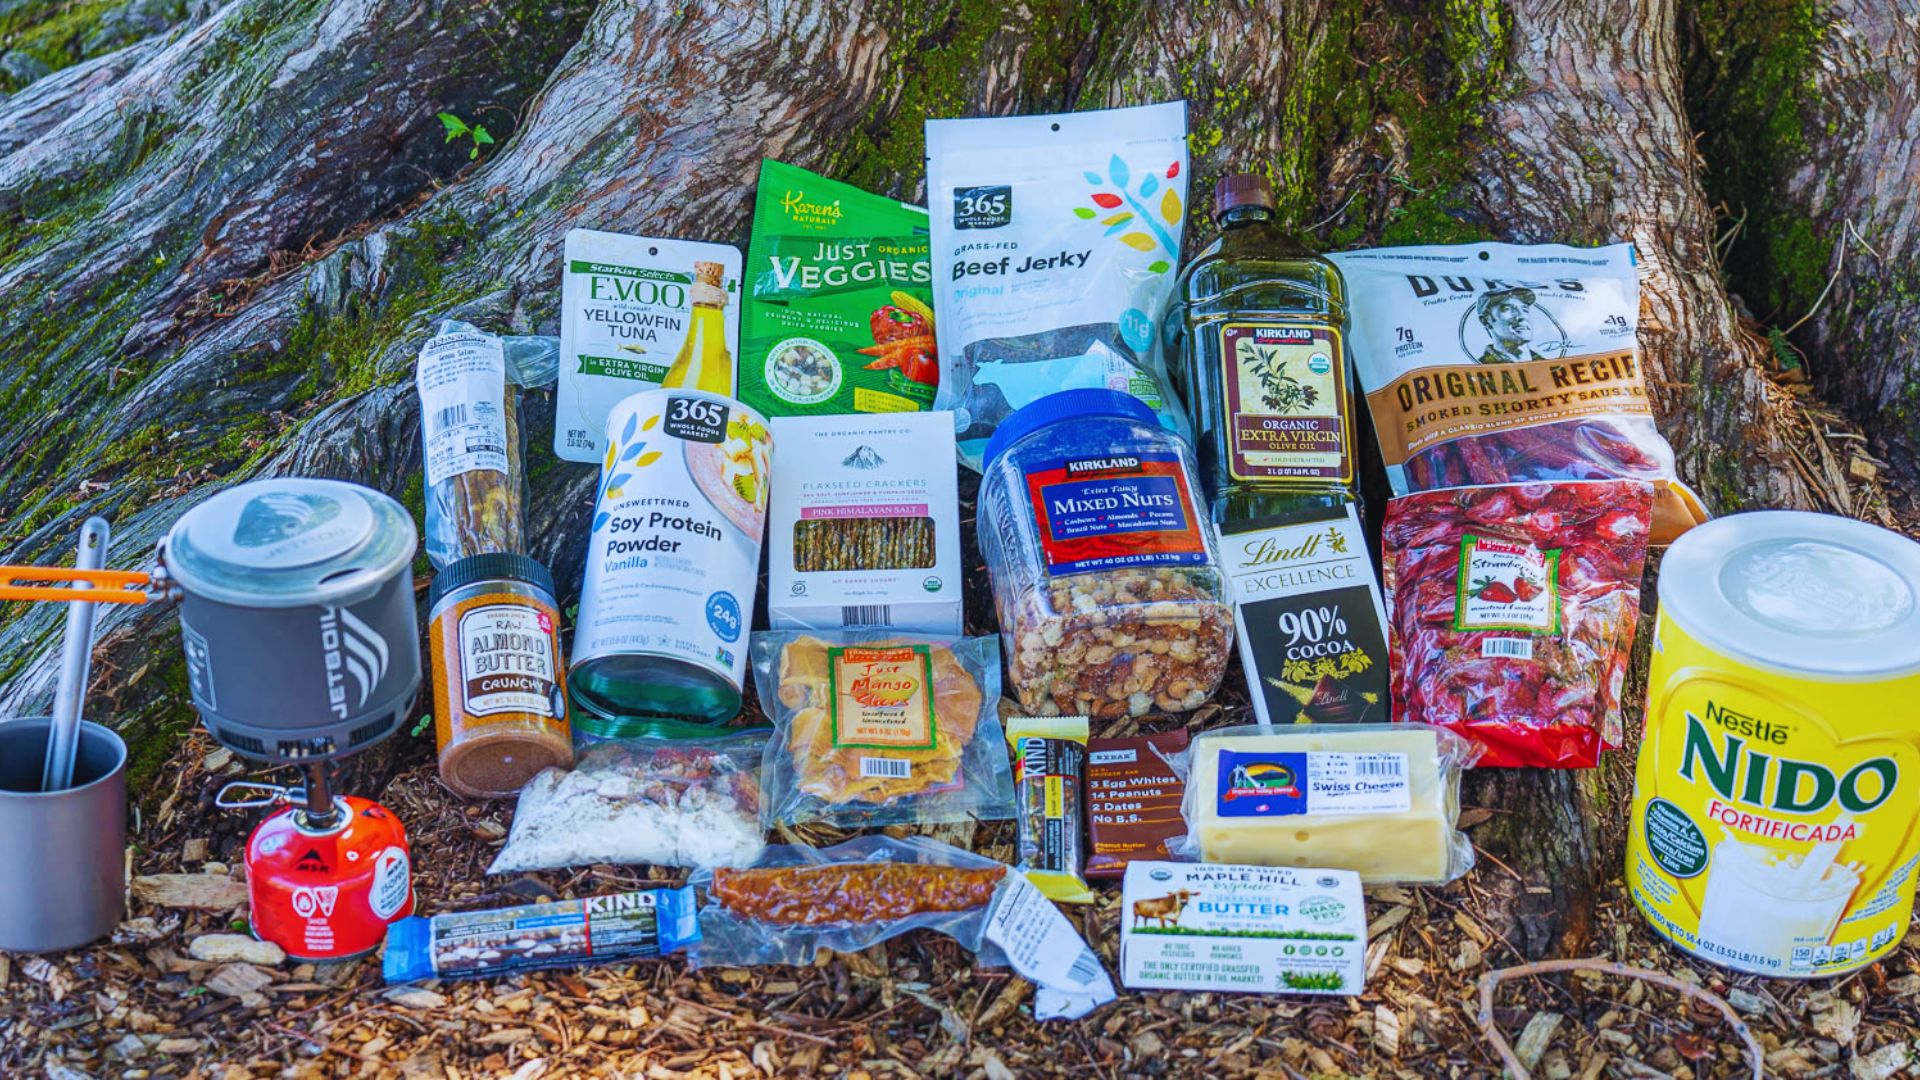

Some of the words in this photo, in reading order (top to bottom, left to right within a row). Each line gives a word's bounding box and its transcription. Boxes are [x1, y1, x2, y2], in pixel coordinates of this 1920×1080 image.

[780, 190, 844, 218] Karen's
[959, 193, 1007, 216] 365
[792, 215, 837, 225] NATURALS
[813, 242, 871, 261] JUST
[878, 245, 929, 255] ORGANIC
[954, 242, 1019, 256] GRASS-FED
[589, 263, 637, 275] StarKist
[639, 270, 676, 281] Selects
[768, 256, 932, 289] VEGGIES
[952, 256, 1011, 281] Beef
[1015, 249, 1092, 274] Jerky
[583, 308, 681, 332] YELLOWFIN
[806, 312, 843, 320] NATURAL
[607, 324, 657, 342] TUNA
[781, 320, 805, 328] DRIED
[809, 324, 844, 333] VEGGIES
[1124, 313, 1150, 338] 11g
[1255, 328, 1311, 339] KIRKLAND
[1395, 326, 1414, 342] 7g
[1395, 341, 1424, 355] PROTEIN
[599, 358, 630, 369] EXTRA
[632, 363, 665, 375] VIRGIN
[604, 368, 632, 377] OLIVE
[634, 371, 649, 380] OIL
[1396, 368, 1538, 412] ORIGINAL
[670, 399, 724, 427] 365
[1406, 405, 1472, 432] SMOKED
[1479, 393, 1570, 416] SHORTY
[669, 422, 696, 431] WHOLE
[696, 426, 720, 436] FOODS
[1262, 420, 1319, 430] ORGANIC
[1448, 423, 1484, 433] CLASSIC
[679, 429, 710, 439] MARKET
[1240, 429, 1289, 441] EXTRA
[1290, 431, 1341, 442] VIRGIN
[1268, 442, 1297, 450] OLIVE
[1068, 457, 1138, 472] KIRKLAND
[802, 481, 861, 490] FLAXSEED
[866, 479, 927, 488] CRACKERS
[1081, 487, 1108, 495] Extra
[1109, 485, 1138, 493] Fancy
[613, 499, 690, 511] UNSWEETENED
[812, 507, 834, 516] PINK
[835, 506, 893, 515] HIMALAYAN
[894, 505, 918, 514] SALT
[1054, 497, 1119, 515] MIXED
[1120, 493, 1174, 508] NUTS
[609, 516, 645, 534] Soy
[648, 512, 722, 541] Protein
[1063, 516, 1096, 526] Cashews
[1106, 512, 1139, 521] Almonds
[1117, 520, 1158, 528] Macadamia
[606, 535, 682, 557] Powder
[1238, 532, 1324, 569] Lindt
[604, 556, 649, 573] Vanilla
[1075, 561, 1090, 569] NET
[1244, 564, 1356, 593] EXCELLENCE
[714, 604, 737, 630] 24g
[496, 620, 521, 630] RAW
[1278, 604, 1347, 647] 90%
[471, 632, 545, 655] ALMOND
[1286, 639, 1356, 660] COCOA
[320, 605, 348, 719] JETBOIL
[474, 653, 546, 675] BUTTER
[860, 662, 901, 677] Just
[481, 677, 544, 692] CRUNCHY
[850, 677, 912, 692] Mango
[1314, 689, 1349, 706] Lindt
[1024, 737, 1047, 775] KIND
[1677, 710, 1899, 816] NIDO
[1090, 780, 1099, 789] 3
[1103, 780, 1127, 789] Egg
[1129, 776, 1177, 786] Whites
[1312, 781, 1351, 792] Swiss
[1355, 780, 1405, 791] Cheese
[1110, 788, 1162, 799] Peanuts
[1091, 803, 1100, 811] 2
[1104, 802, 1142, 811] Dates
[1093, 815, 1112, 823] No
[1116, 813, 1142, 823] B.S.
[1708, 800, 1857, 842] FORTIFICADA
[1648, 816, 1705, 857] Calcio/Calcium
[1652, 834, 1696, 866] Hierro/Iron
[296, 863, 330, 873] MSR
[1662, 855, 1680, 871] Zinc
[1230, 867, 1292, 876] GRASSFED
[1186, 873, 1251, 882] MAPLE
[1259, 874, 1301, 886] HILL
[585, 892, 657, 914] KIND
[1198, 902, 1290, 916] BUTTER
[1299, 902, 1346, 915] GRASS
[1312, 911, 1341, 920] FED
[1666, 921, 1685, 938] NETO
[1685, 932, 1702, 947] 56.4
[1703, 941, 1716, 951] OZ
[1716, 945, 1738, 959] (3.52
[1766, 956, 1782, 968] kg)
[1795, 948, 1810, 957] 150
[1144, 961, 1157, 969] THE
[1160, 962, 1179, 970] ONLY
[1180, 962, 1220, 972] CERTIFIED
[1221, 964, 1260, 973] GRASSFED
[1139, 970, 1171, 980] ORGANIC
[1173, 972, 1202, 981] BUTTER
[1203, 973, 1212, 981] IN
[1215, 973, 1228, 982] THE
